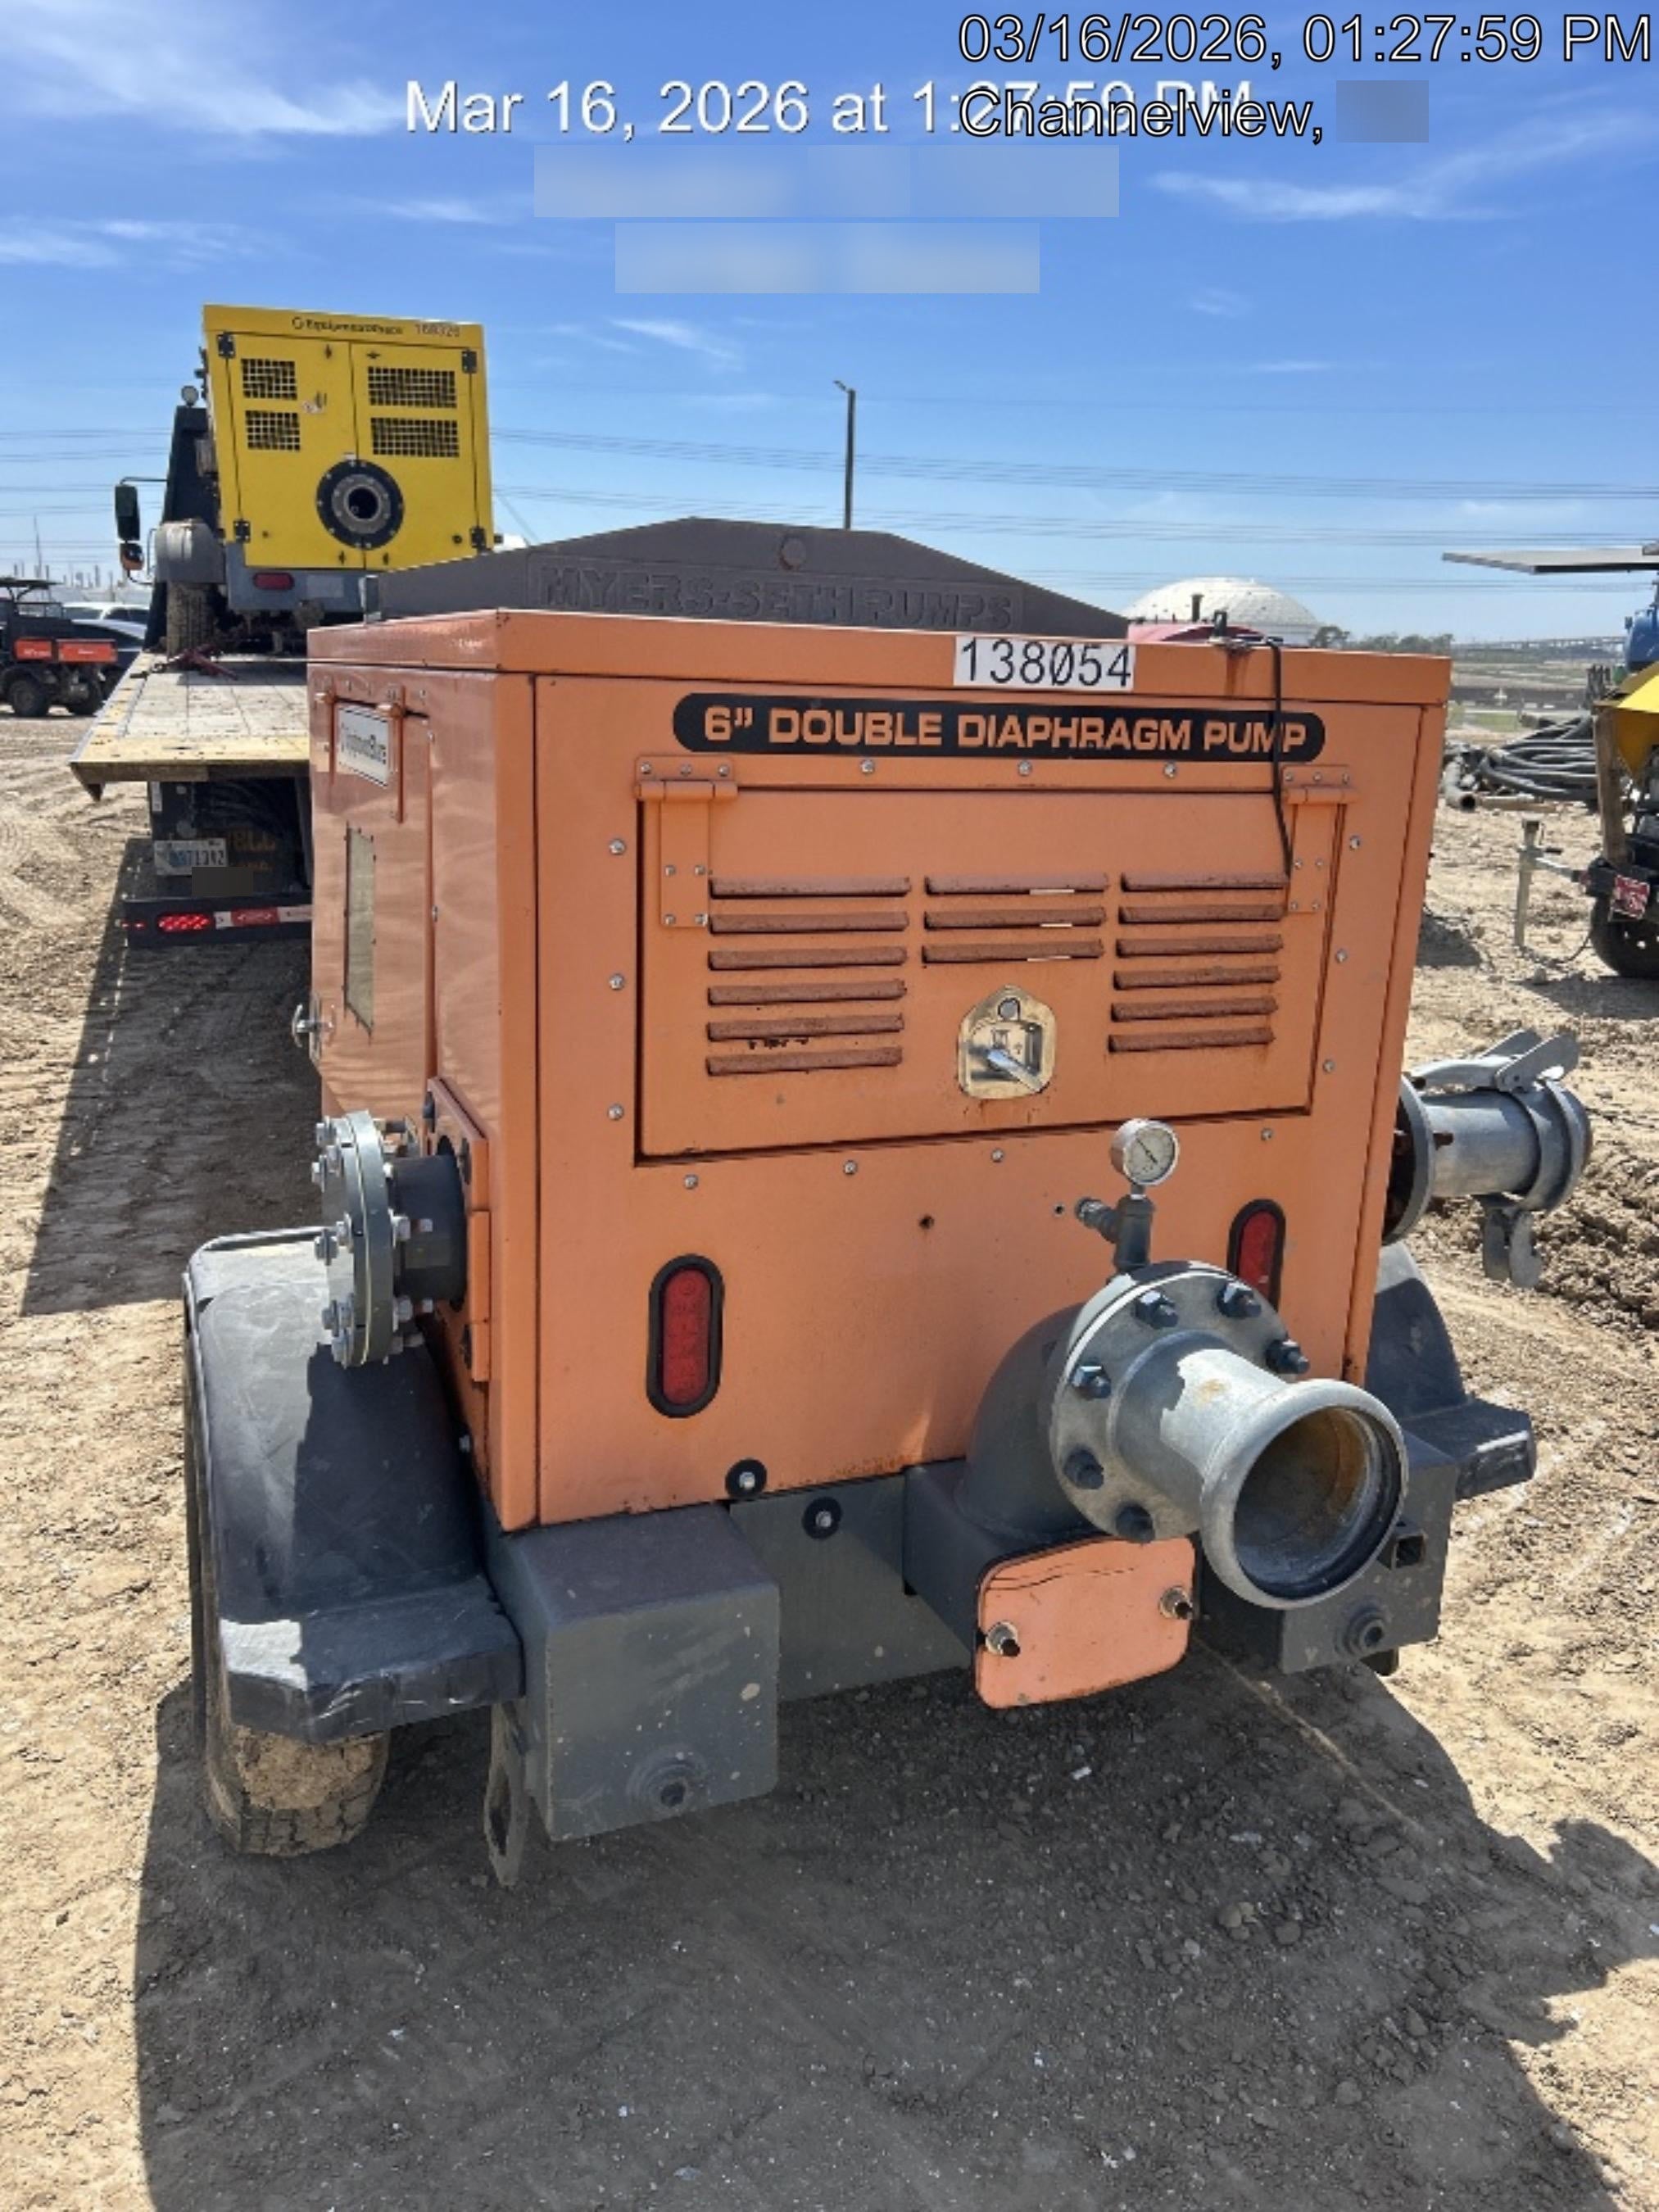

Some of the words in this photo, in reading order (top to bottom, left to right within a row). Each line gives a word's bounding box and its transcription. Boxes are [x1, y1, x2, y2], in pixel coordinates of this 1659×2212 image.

[864, 587, 1013, 631] PUMPS
[960, 639, 1132, 689] 138054
[768, 707, 943, 746] DOUBLE
[957, 714, 1191, 751] DIAPHRAGM
[1203, 719, 1307, 754] PUMP
